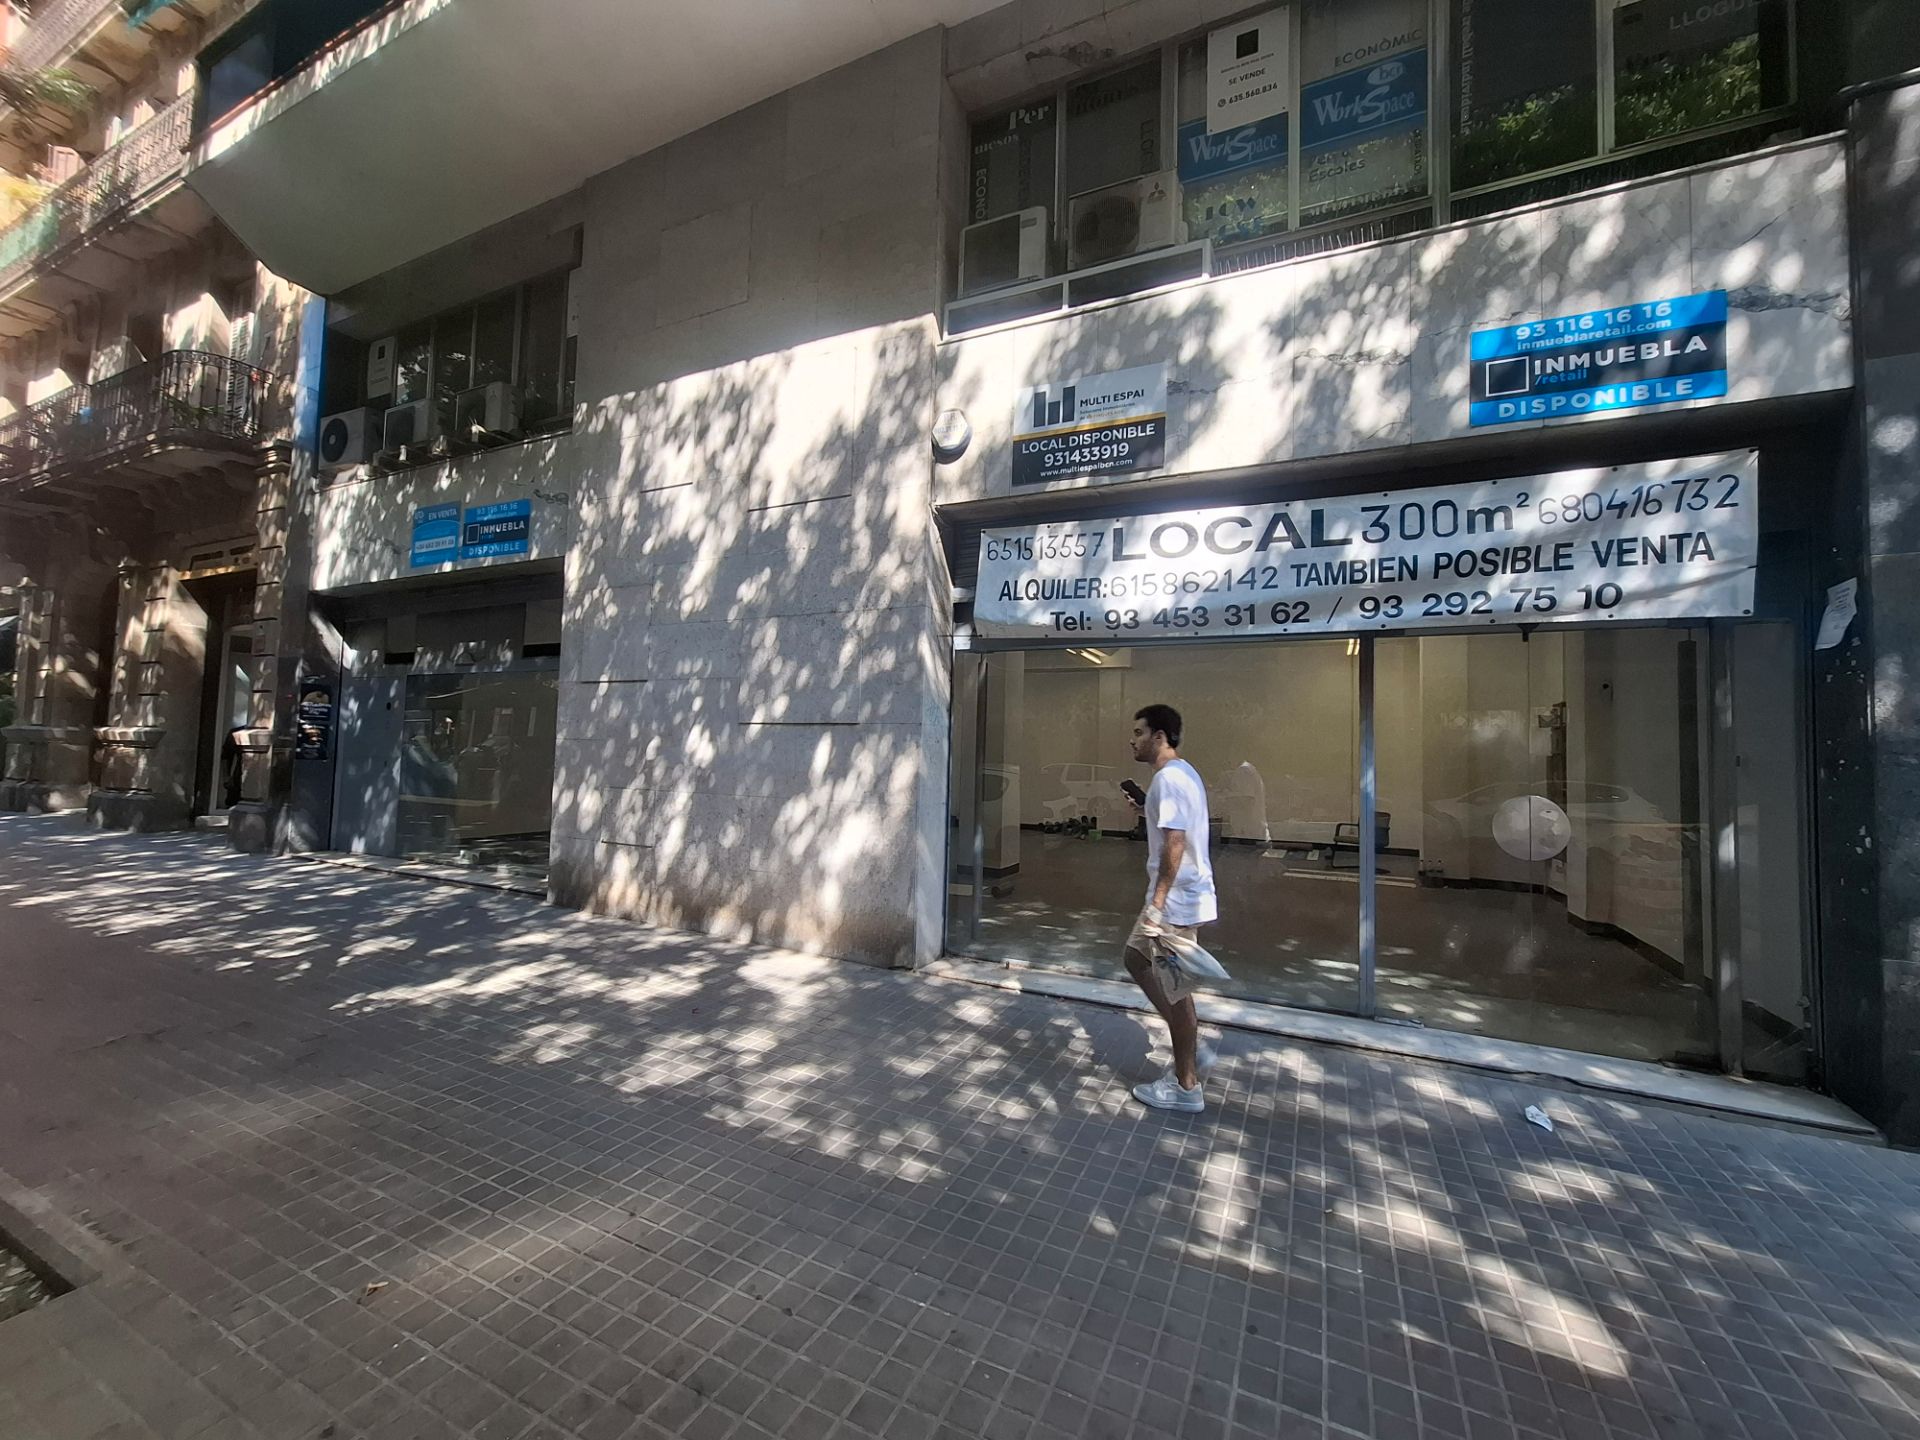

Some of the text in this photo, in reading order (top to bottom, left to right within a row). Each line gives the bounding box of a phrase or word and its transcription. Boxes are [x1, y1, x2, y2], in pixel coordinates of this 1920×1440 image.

[1669, 0, 1758, 30] LLOGU
[1334, 29, 1423, 67] ECONÒMIC
[1228, 68, 1267, 86] SE VENDE
[1009, 106, 1050, 129] Per
[1312, 85, 1416, 126] WorkSpace
[1187, 127, 1278, 164] WorkSpace
[1309, 159, 1366, 182] Escoles
[1515, 302, 1672, 340] 93 116 16 16
[1517, 319, 1672, 351] inmueblaretail.com
[1534, 336, 1708, 376] INMUEBLA
[1535, 368, 1588, 386] /retail
[1079, 395, 1111, 408] MULTI
[1113, 389, 1145, 402] ESPAI
[1499, 378, 1694, 418] DISPONIBLE
[1022, 423, 1156, 455] LOCAL DISPONIBLE
[1044, 442, 1130, 468] 931433919
[428, 512, 437, 520] EN
[438, 508, 457, 519] VENTA
[480, 520, 525, 534] INMUEBLA
[986, 531, 1104, 562] 651513557
[1111, 508, 1354, 563] LOCAL
[1538, 473, 1740, 526] 680416732
[469, 542, 520, 556] DISPONIBLE
[998, 531, 1715, 602] ALQUILER: 615862142 TAMBIEN POSIBLE VENTA
[1050, 582, 1624, 632] Tel: 93 453 31 62 / 93 292 75 10
